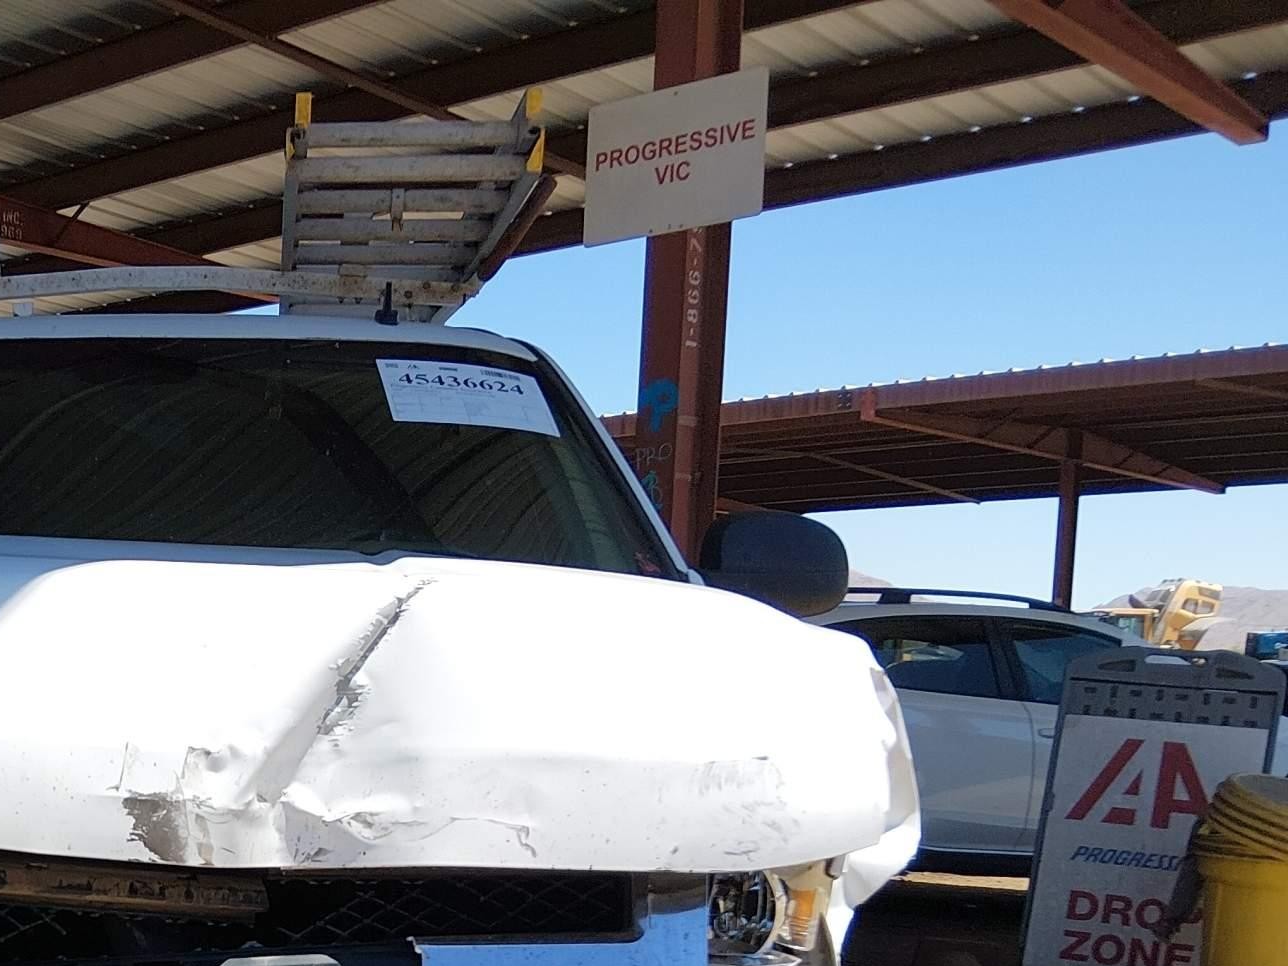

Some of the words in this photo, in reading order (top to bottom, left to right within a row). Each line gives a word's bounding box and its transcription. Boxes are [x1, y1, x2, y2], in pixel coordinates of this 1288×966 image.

[595, 119, 756, 172] PROGRESSIVE
[654, 162, 691, 185] VIC
[398, 373, 525, 395] 45436624
[1065, 889, 1203, 931] DRO
